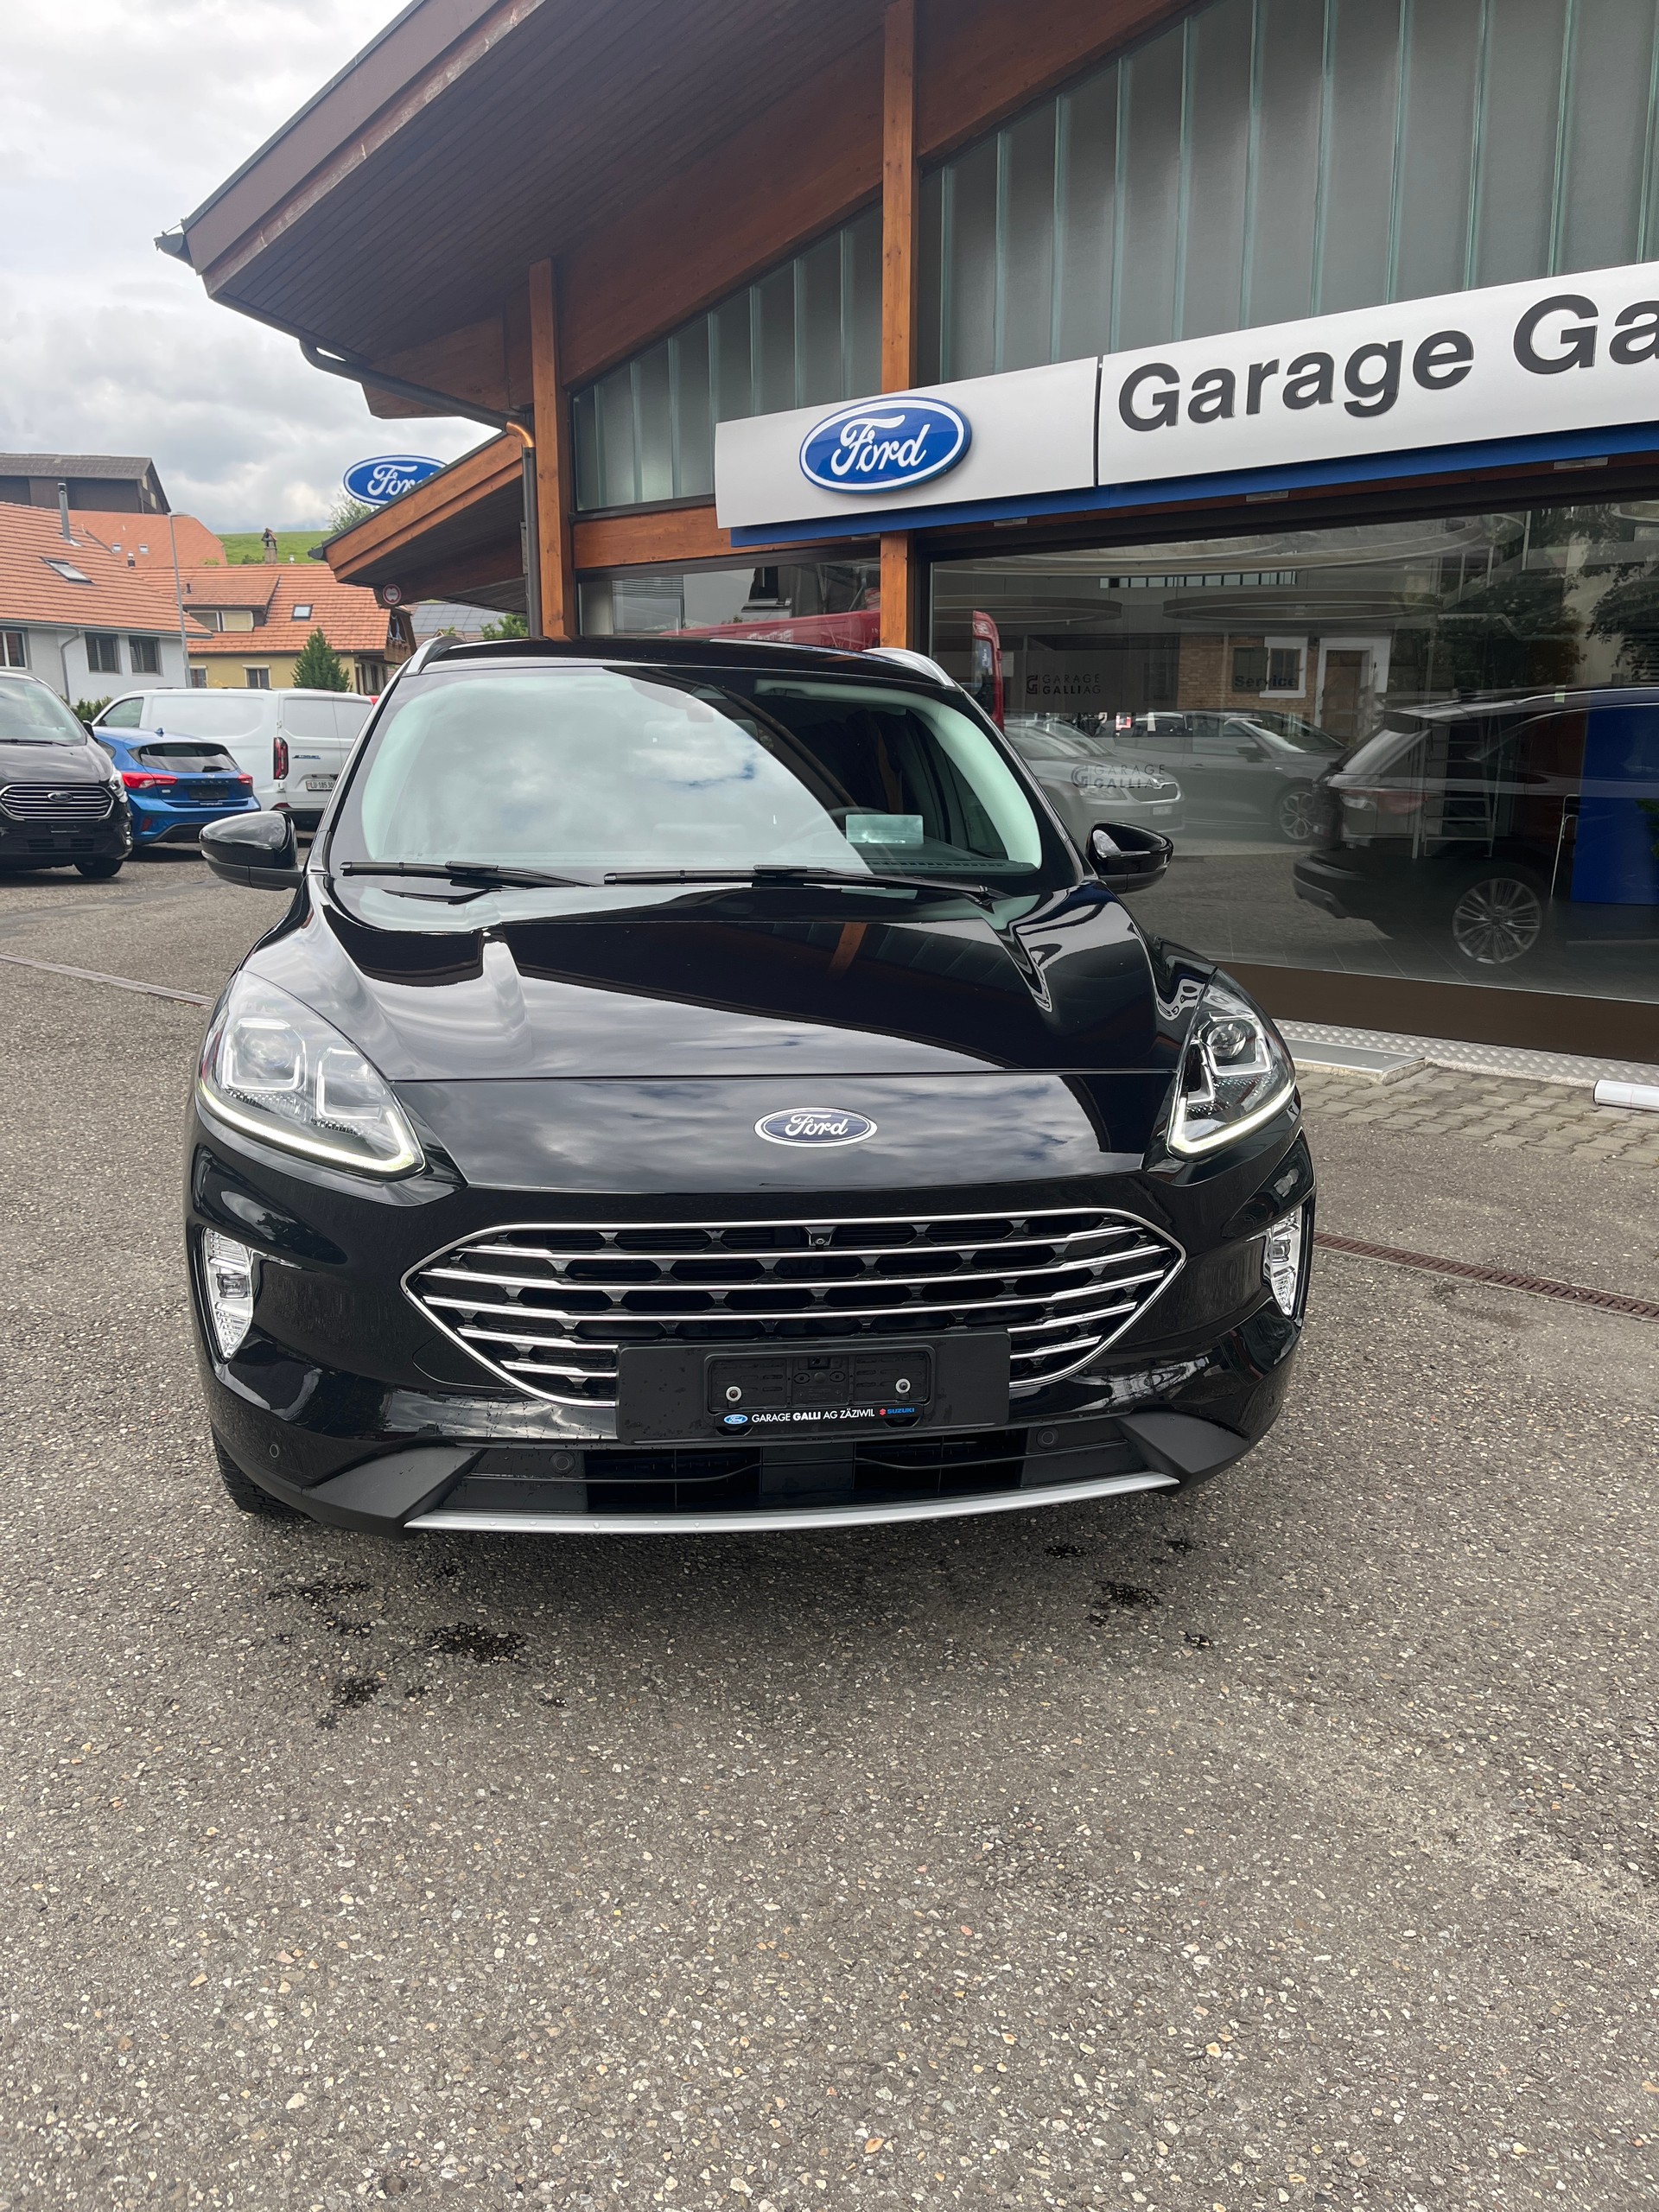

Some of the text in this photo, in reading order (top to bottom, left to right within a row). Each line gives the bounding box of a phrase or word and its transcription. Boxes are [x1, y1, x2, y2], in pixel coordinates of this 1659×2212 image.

[1119, 294, 1659, 432] Garage Ga
[830, 414, 931, 476] Ford
[366, 464, 435, 496] For
[1042, 674, 1100, 684] GARAGE
[1234, 675, 1297, 688] Service
[1094, 764, 1166, 776] GARAGE
[785, 1113, 849, 1137] Ford
[751, 1412, 791, 1423] GARAGE
[792, 1411, 821, 1421] GALLI
[823, 1410, 838, 1420] AG
[840, 1408, 875, 1419] ZÄZIWIL
